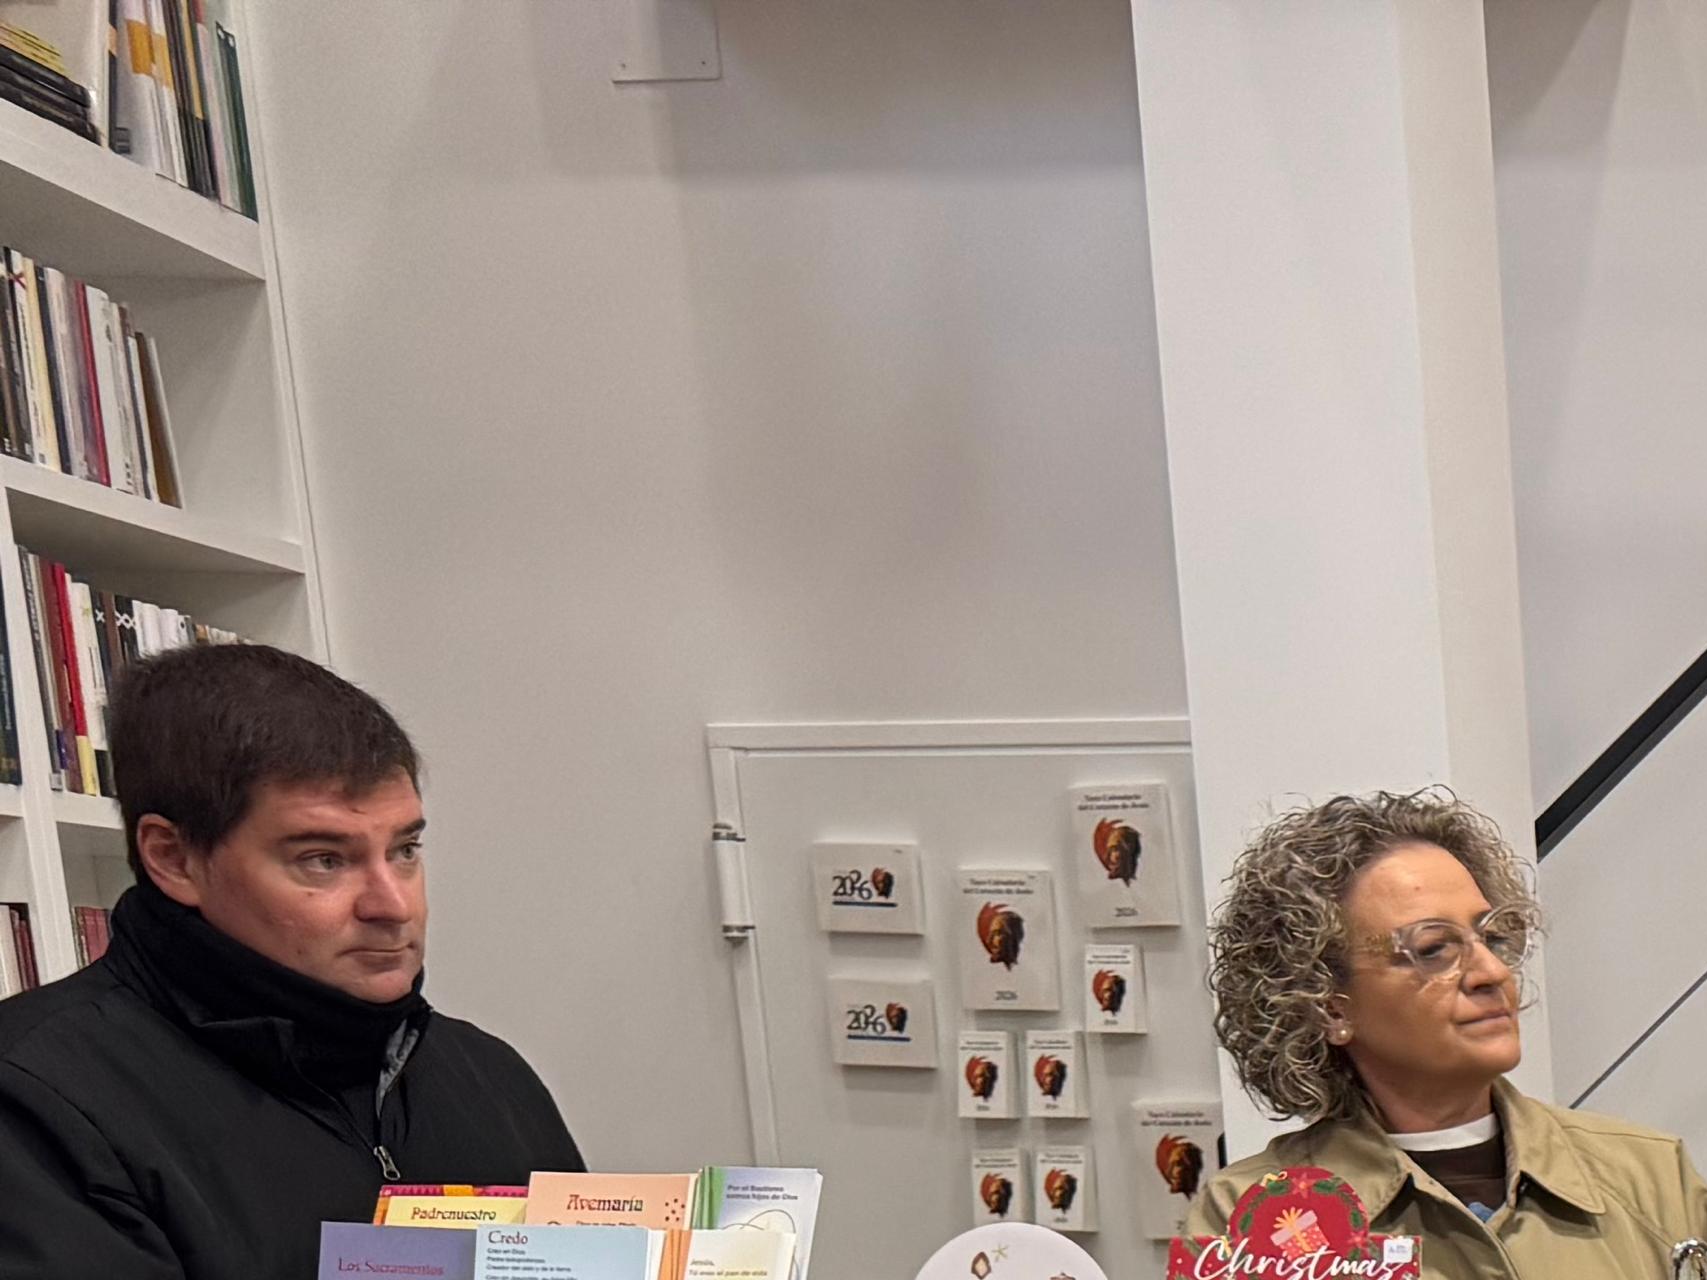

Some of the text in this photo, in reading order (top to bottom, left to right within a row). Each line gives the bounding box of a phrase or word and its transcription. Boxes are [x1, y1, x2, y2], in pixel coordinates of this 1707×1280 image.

[566, 1194, 644, 1212] Avemaría
[410, 1207, 496, 1222] Padrenuestro
[488, 1230, 528, 1246] Credo
